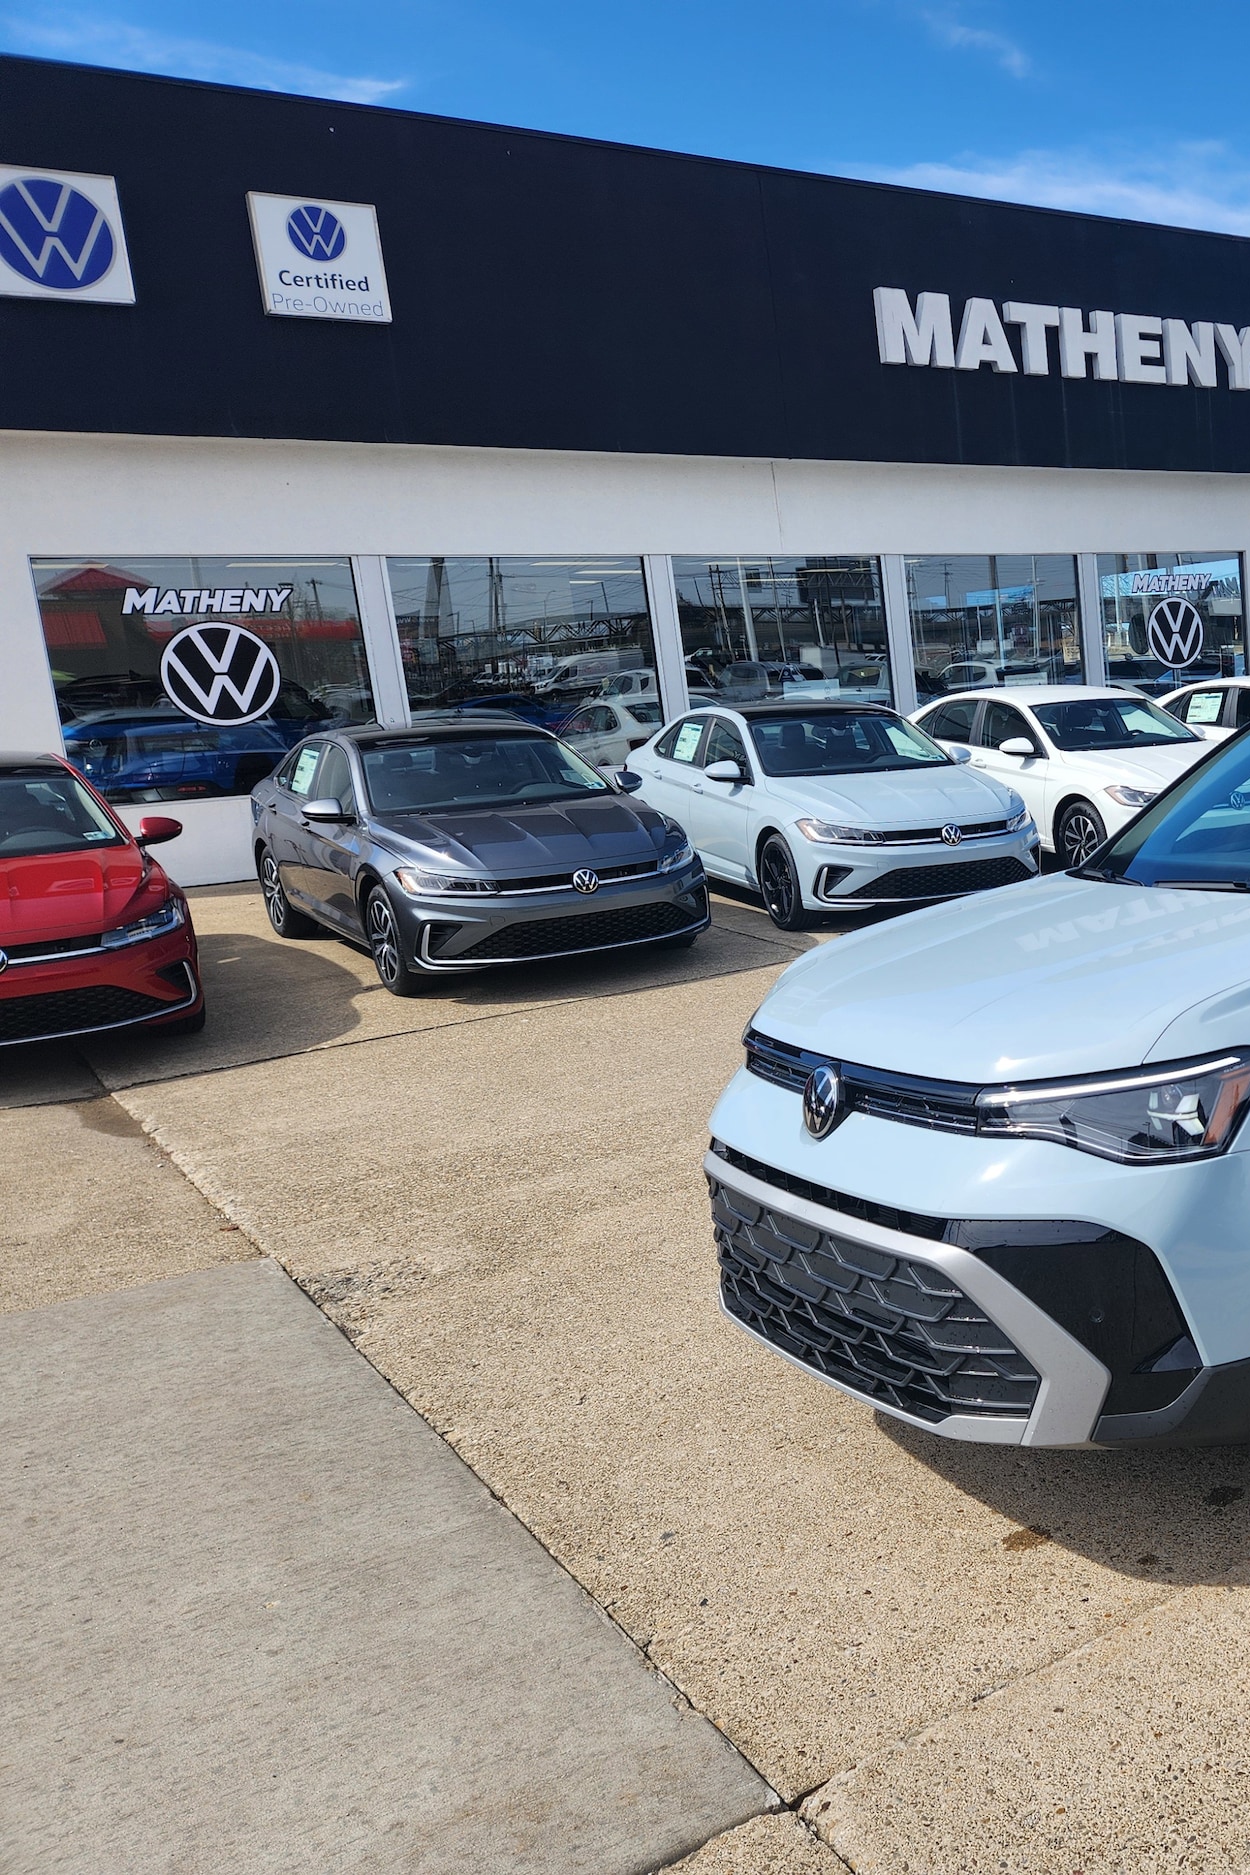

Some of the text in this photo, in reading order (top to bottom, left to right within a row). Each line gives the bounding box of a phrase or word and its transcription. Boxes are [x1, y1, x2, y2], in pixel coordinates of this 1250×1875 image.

[287, 206, 345, 260] VW
[278, 269, 370, 292] Certified
[271, 292, 385, 317] Pre-Owned
[1131, 573, 1212, 593] MATHENY
[121, 586, 293, 615] MATHENY
[1150, 598, 1201, 665] VW
[163, 624, 278, 721] VW
